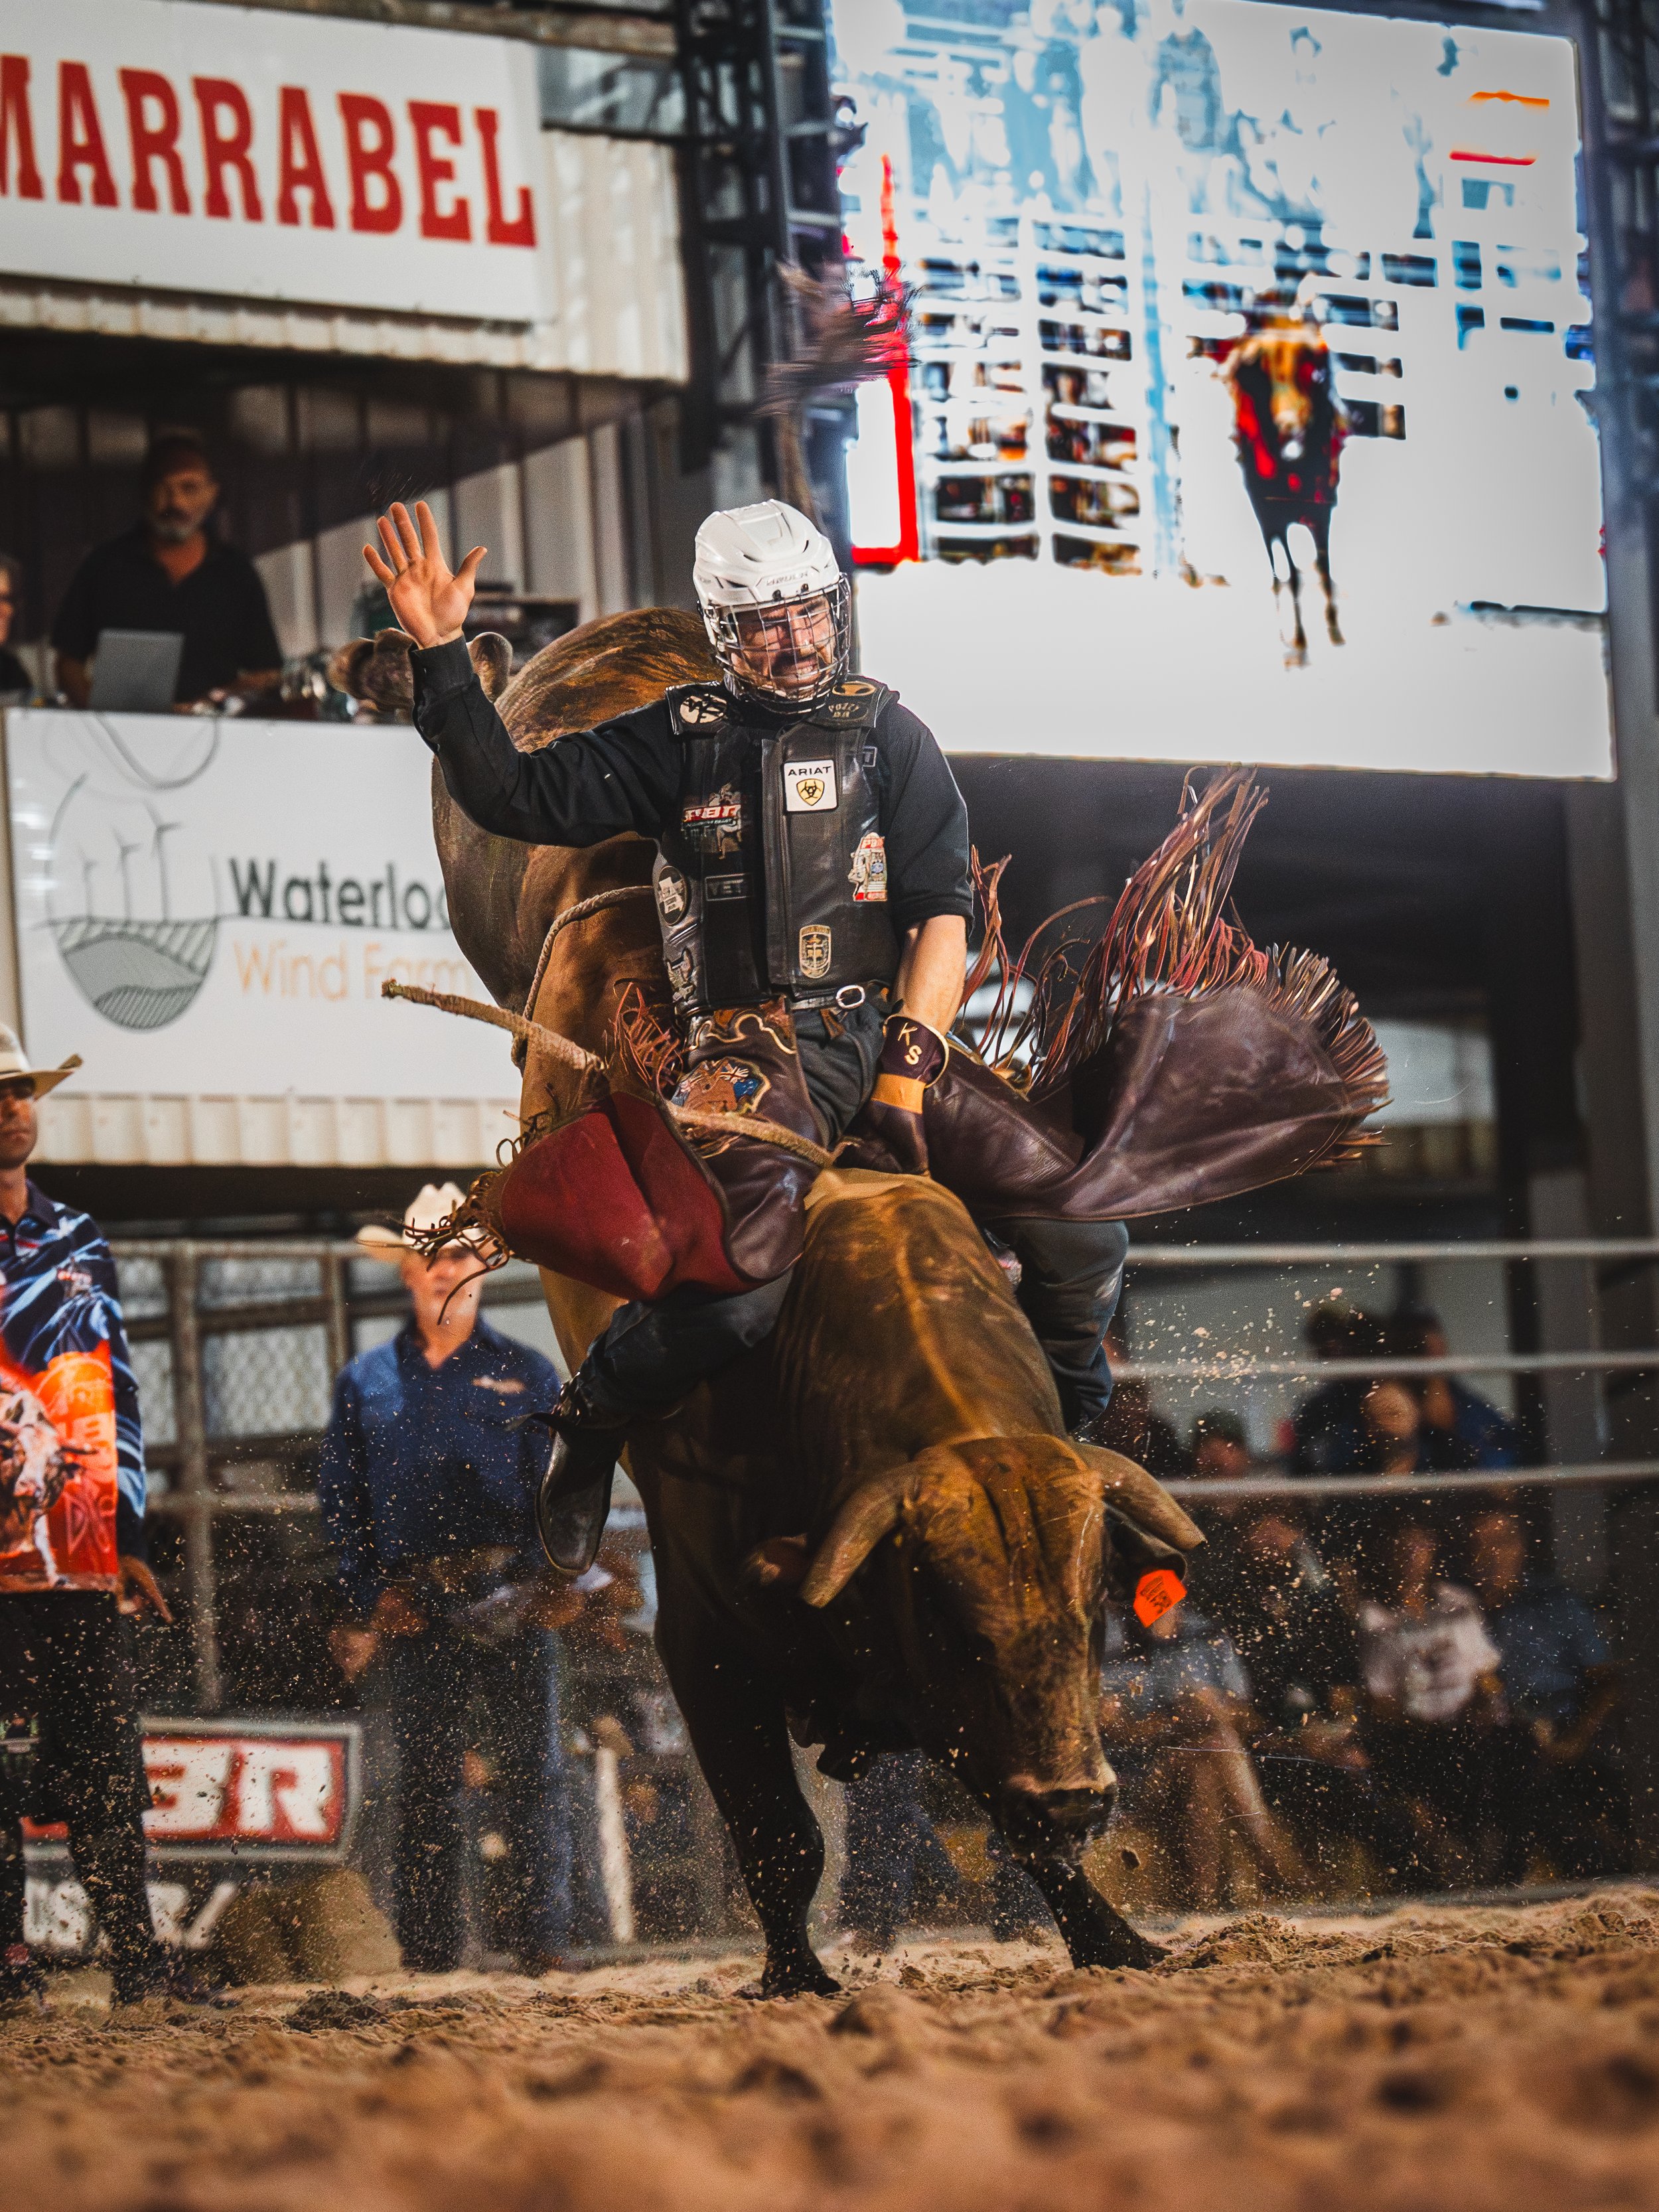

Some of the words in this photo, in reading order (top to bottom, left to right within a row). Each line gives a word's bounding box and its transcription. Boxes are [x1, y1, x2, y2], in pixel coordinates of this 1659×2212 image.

[788, 766, 831, 776] ARIAT
[233, 939, 348, 1001] Wind
[365, 941, 472, 998] Farm
[141, 1739, 330, 1834] BR
